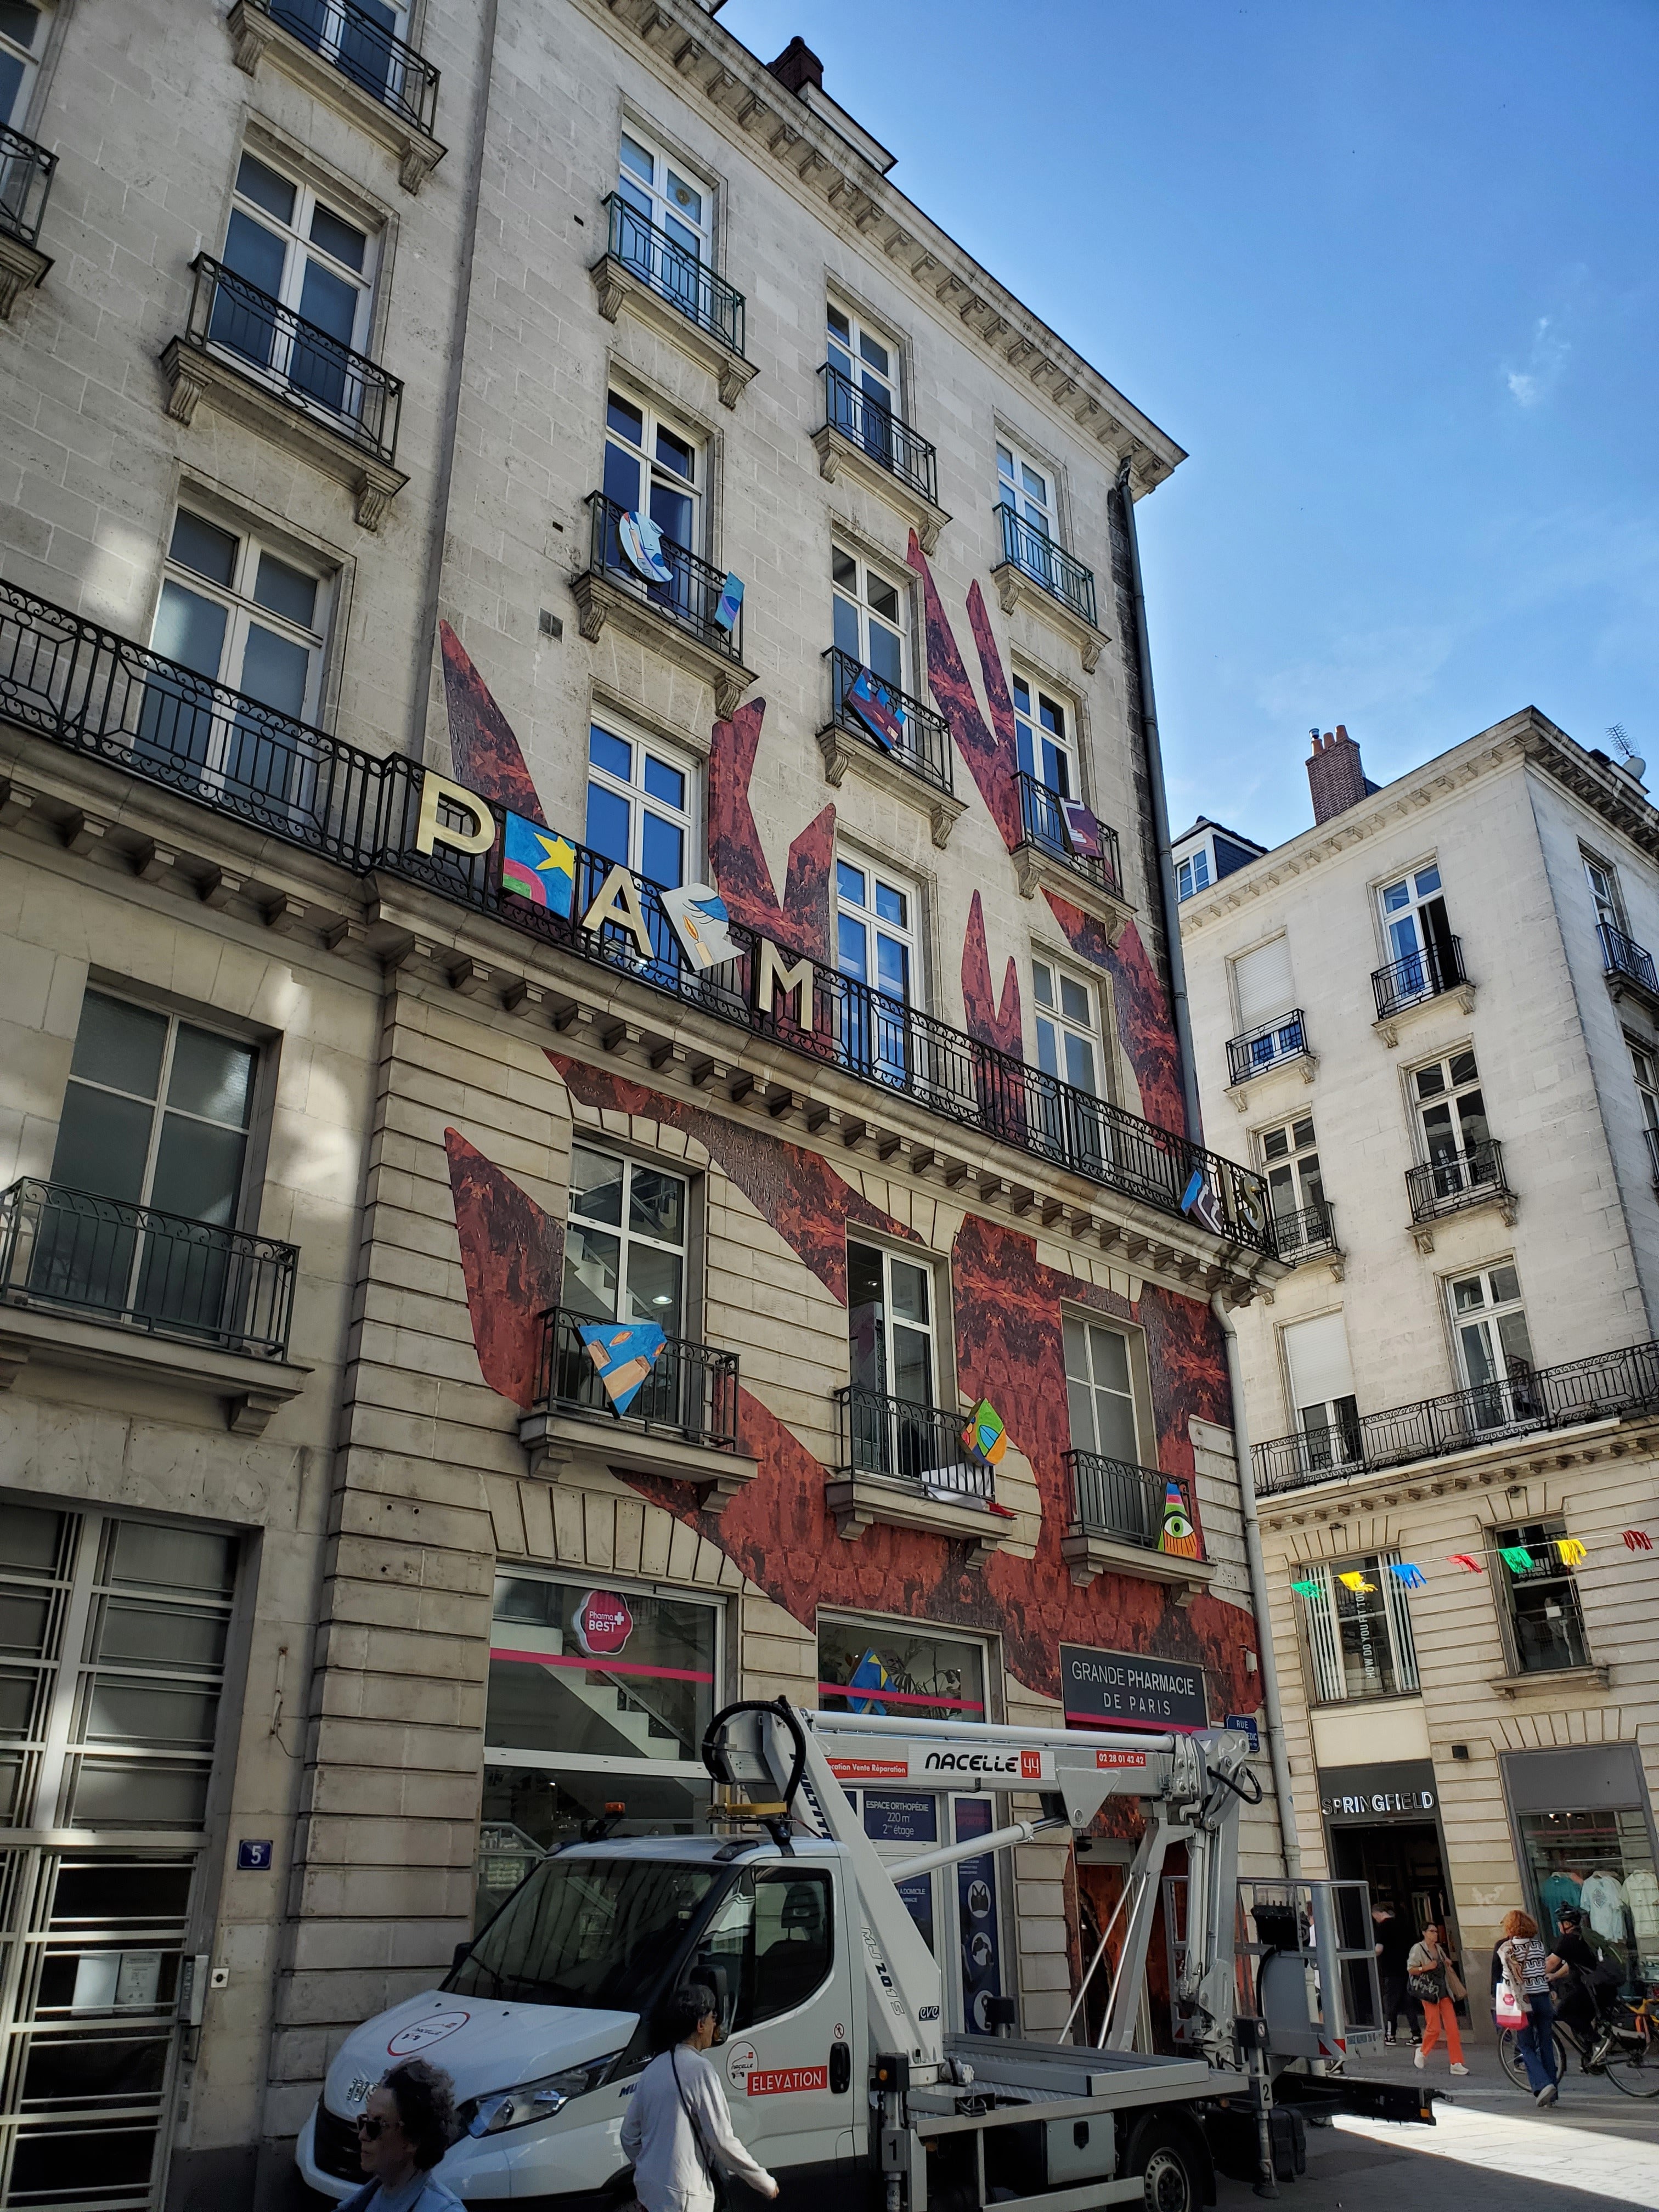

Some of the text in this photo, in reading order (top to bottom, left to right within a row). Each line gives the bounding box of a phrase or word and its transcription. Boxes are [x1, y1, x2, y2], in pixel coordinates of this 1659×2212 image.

[589, 1611, 614, 1621] Pharma
[1355, 1591, 1375, 1679] HOW DO YOU FIT TOD
[1072, 1661, 1195, 1696] GRANDE PHARMACIE
[1103, 1692, 1171, 1716] DE PARIS
[1236, 1719, 1249, 1729] RUE
[1247, 1733, 1257, 1741] EDIC
[1024, 1757, 1039, 1774] 44
[1099, 1753, 1144, 1764] 02 28 01 42 42
[831, 1763, 906, 1774] cation Vente Réparation
[866, 1800, 929, 1812] ESPACE ORTHOPÉDIE
[1322, 1791, 1434, 1815] SPRINGFIELD
[887, 1812, 900, 1822] 220
[893, 1825, 915, 1837] étage
[251, 1845, 262, 1864] 5
[752, 2070, 822, 2092] ELEVATION
[1263, 2084, 1270, 2102] 2
[888, 2139, 897, 2161] 1
